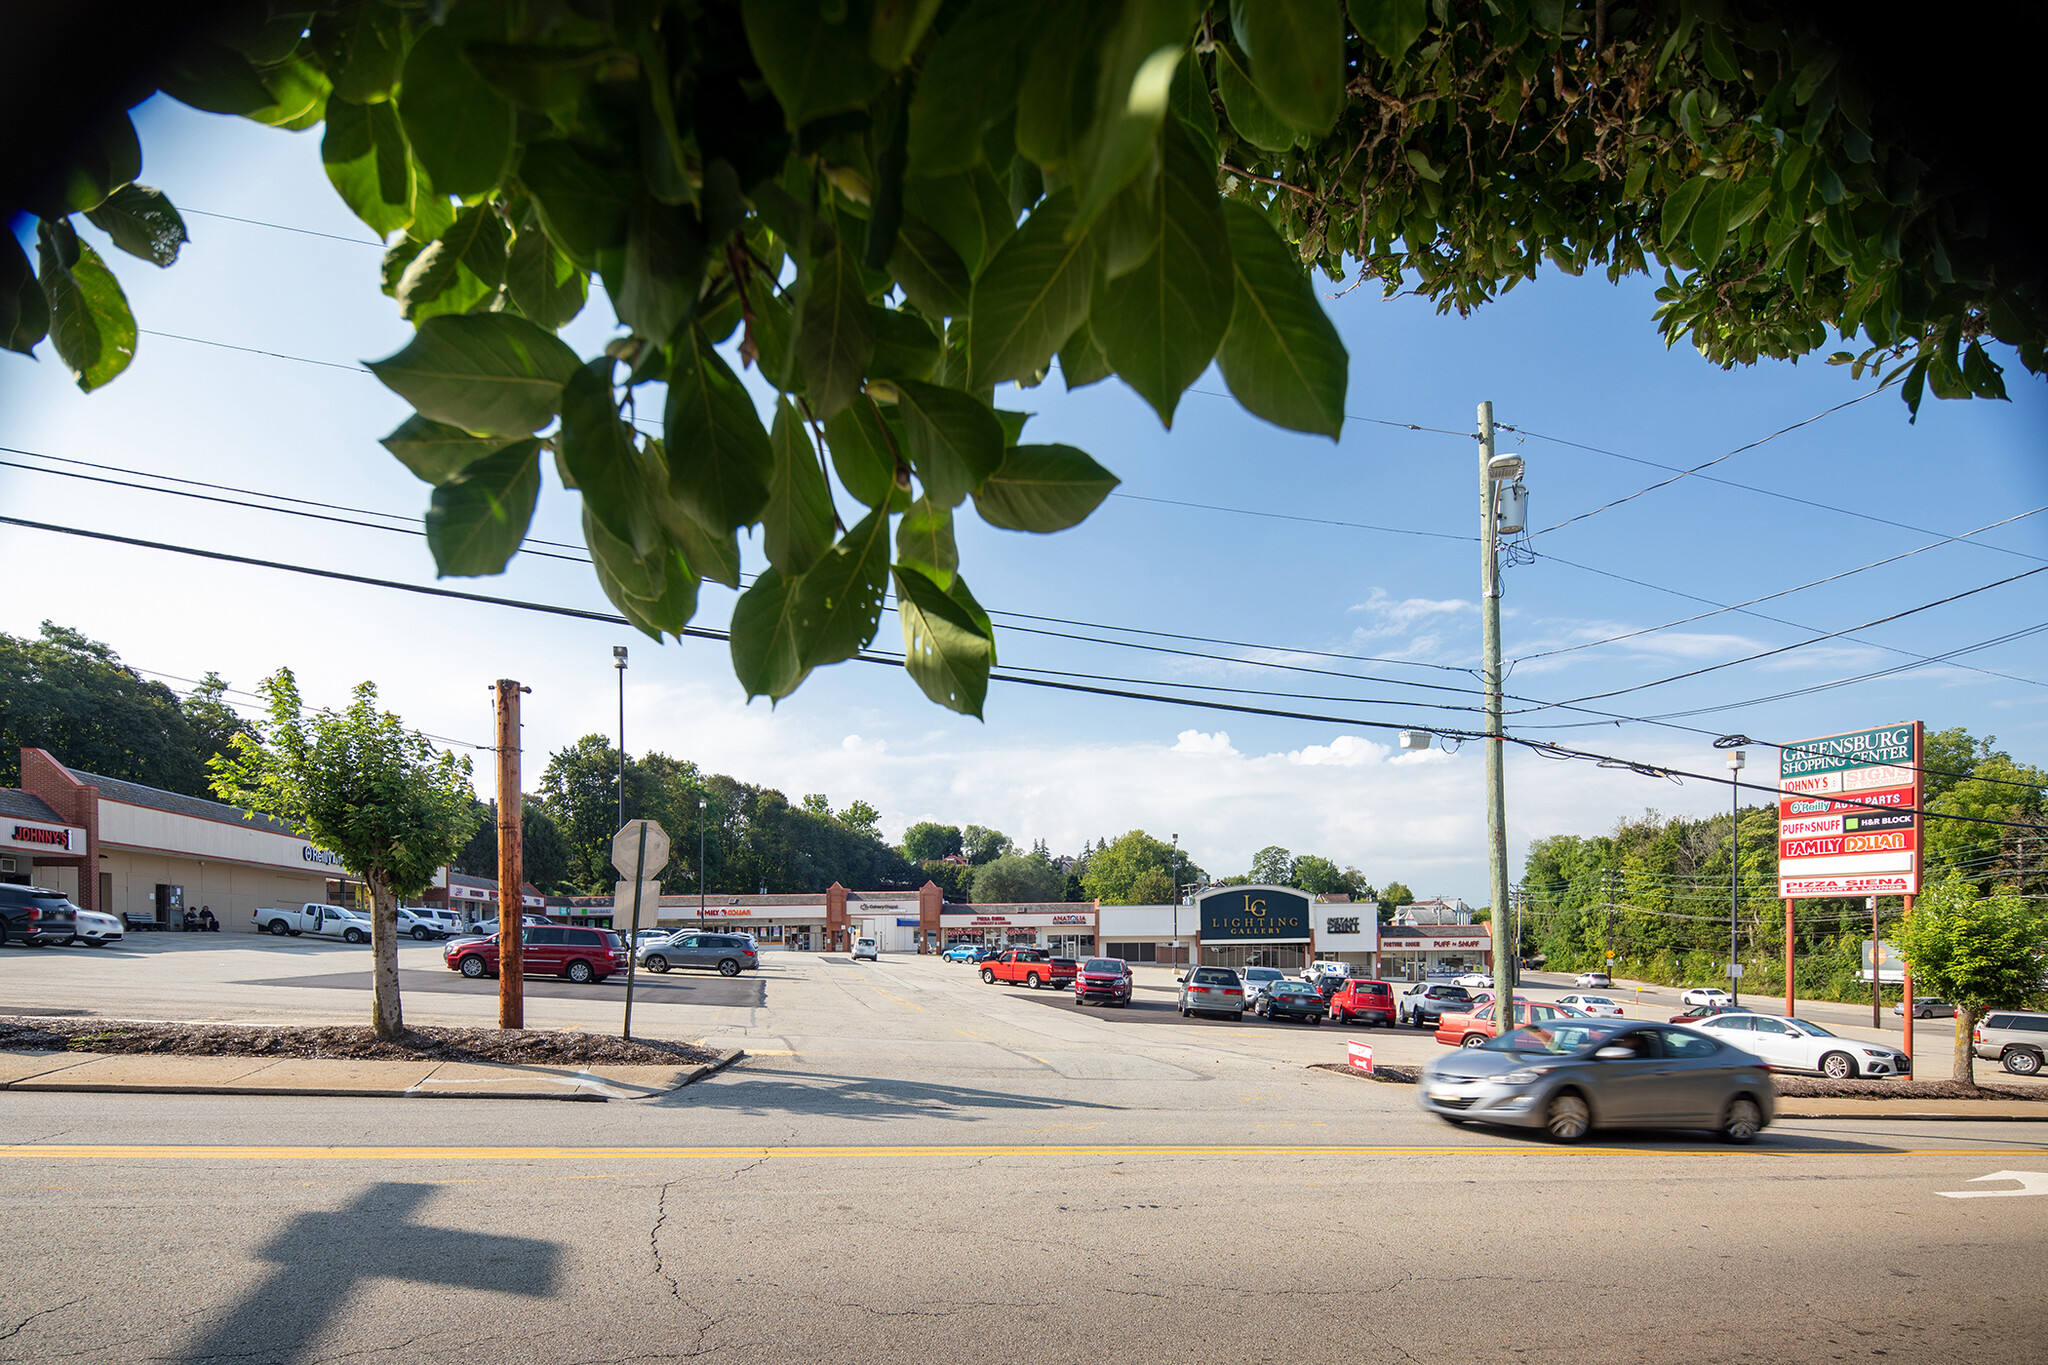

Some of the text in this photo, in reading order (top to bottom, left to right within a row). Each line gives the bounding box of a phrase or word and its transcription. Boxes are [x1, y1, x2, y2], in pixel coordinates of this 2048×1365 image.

[1782, 728, 1910, 763] GREENSBURG
[1782, 745, 1910, 775] SHOPPING CENTER
[1846, 764, 1911, 783] SIGNS
[1784, 776, 1829, 795] JOHNNY'S
[1860, 775, 1910, 788] TOMORROW
[1790, 799, 1831, 814] O'Reilly
[1865, 793, 1901, 806] PARTS
[1782, 819, 1804, 835] PUFF
[1811, 818, 1841, 833] SNUFF
[1861, 815, 1912, 827] H&R BLOCK
[15, 826, 68, 846] JOHNNY'S
[1787, 833, 1904, 856] FAMILY DOLLAR
[1786, 877, 1907, 889] PIZZA SIENA
[1243, 894, 1267, 917] LG
[1052, 914, 1087, 922] ANATOLIA
[1213, 917, 1299, 928] LIGHTING
[1327, 917, 1360, 925] INSTANT
[1230, 927, 1282, 935] GALLERY
[1327, 923, 1360, 932] PRINT
[1433, 940, 1451, 948] PUFF
[1458, 940, 1480, 948] SNUFF
